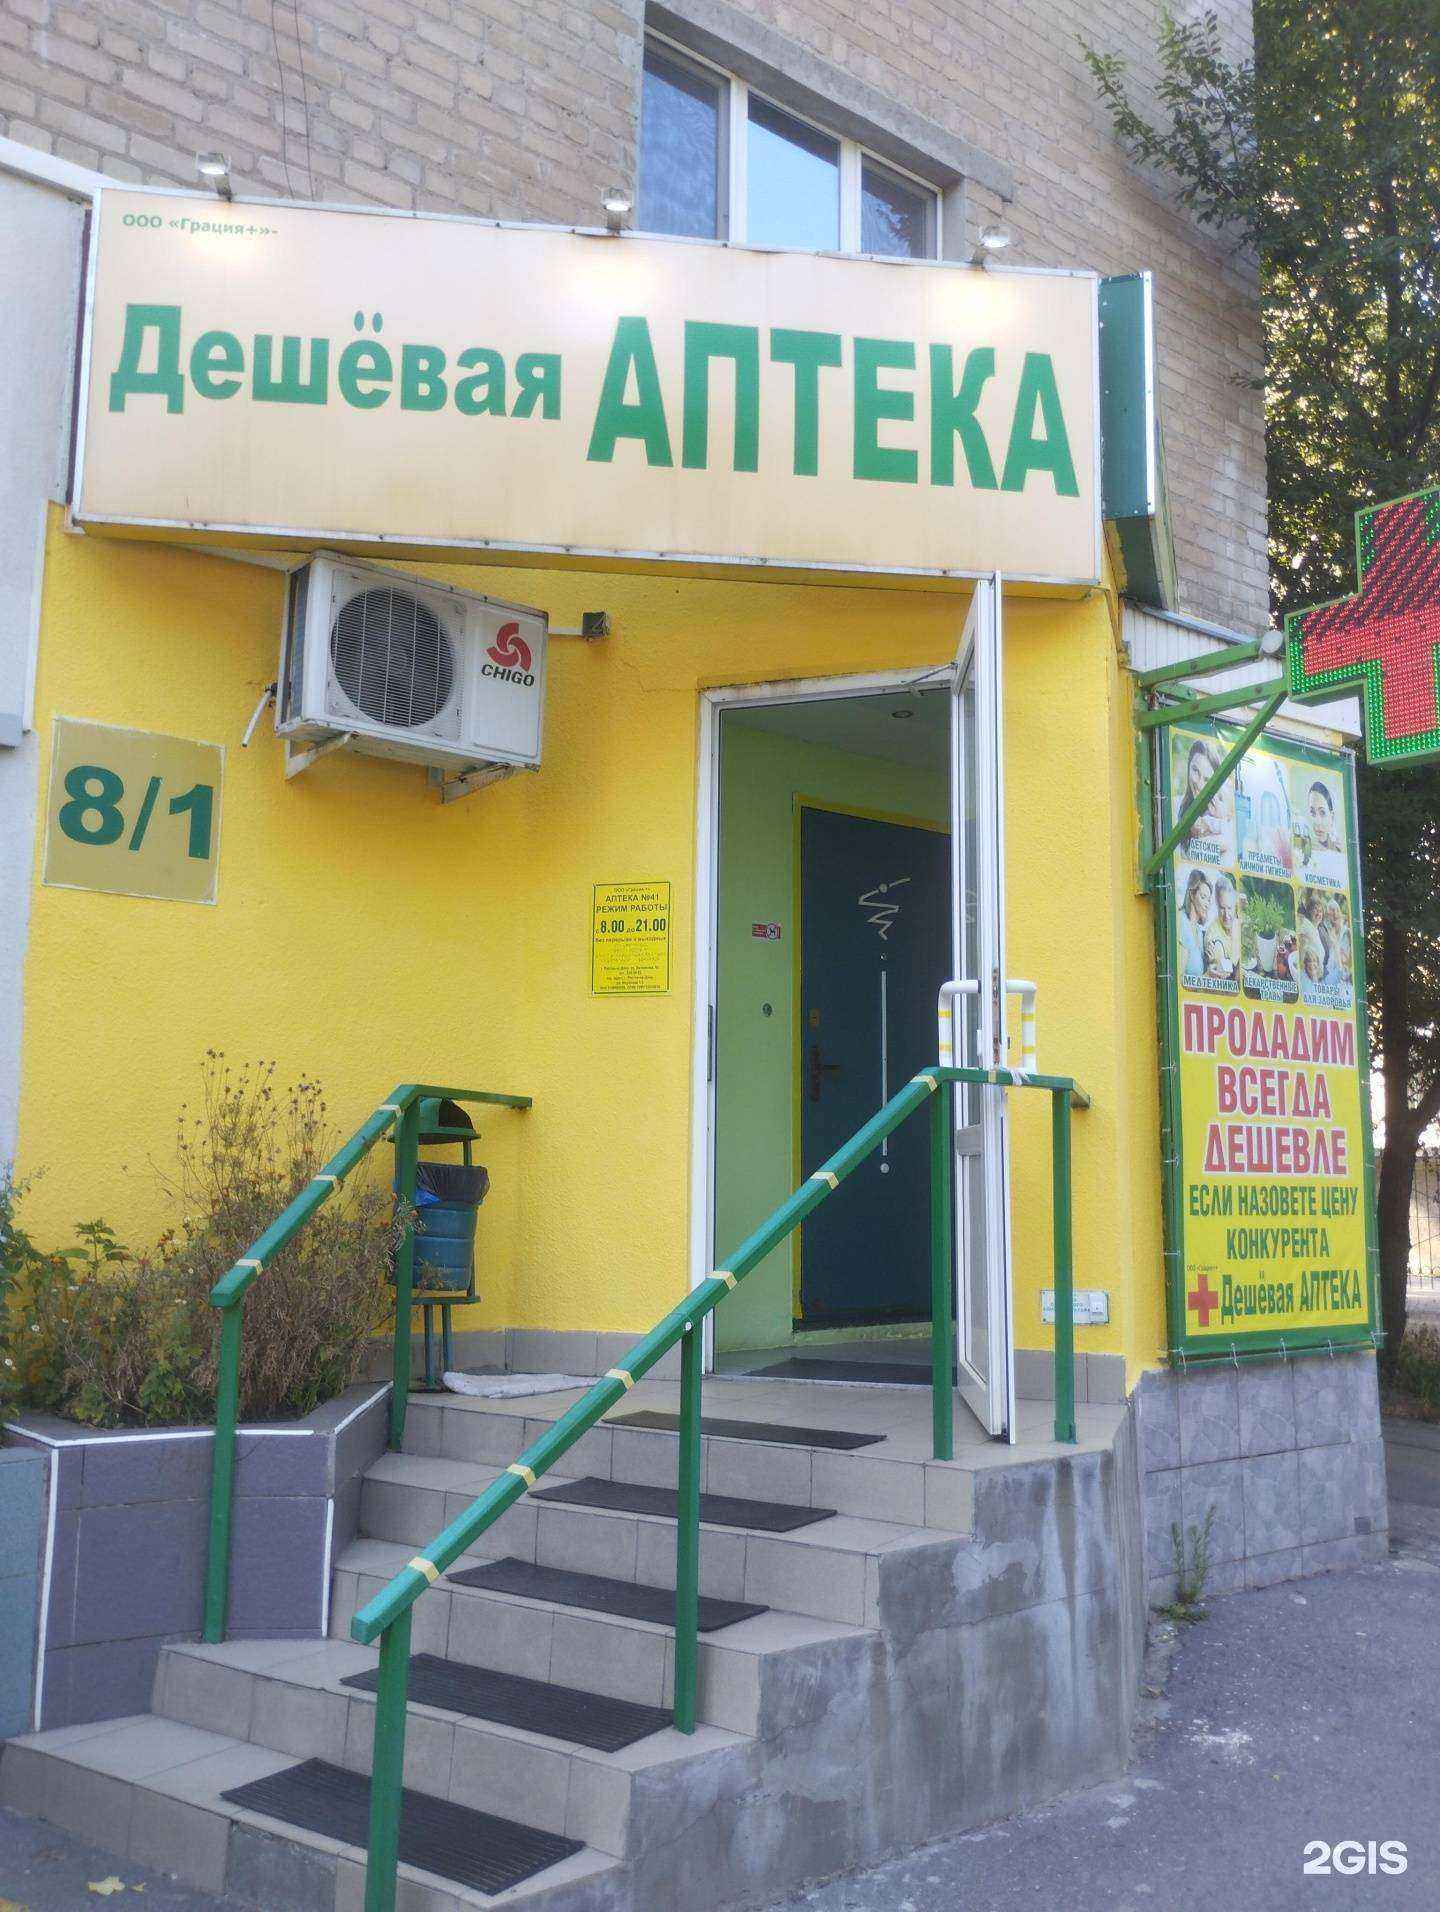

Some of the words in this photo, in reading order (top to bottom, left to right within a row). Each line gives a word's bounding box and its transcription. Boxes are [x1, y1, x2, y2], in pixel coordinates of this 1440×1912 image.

[122, 213, 162, 228] ООО
[109, 302, 562, 421] Дешёвая
[586, 316, 1080, 498] АПТЕКА
[481, 664, 535, 687] CHIGO
[59, 765, 213, 860] 8/1
[596, 905, 628, 914] РЕЖИМ
[630, 903, 667, 912] РАБОТЫ
[606, 894, 638, 902] АПТЕКА
[600, 920, 625, 934] 8.00
[636, 918, 666, 932] 21.00
[1183, 1004, 1355, 1067] ПРОДАДИМ
[1217, 1065, 1332, 1119] ВСЕГДА
[1204, 1124, 1347, 1175] ДЕШЕВЛЕ
[1189, 1184, 1233, 1217] ЕСЛИ
[1238, 1184, 1317, 1217] НАЗОВЕТЕ
[1320, 1185, 1358, 1219] ЦЕНУ
[1226, 1227, 1330, 1260] КОНКУРЕНТА
[1221, 1270, 1294, 1325] Дешёвая
[1300, 1269, 1362, 1312] АПТЕКА
